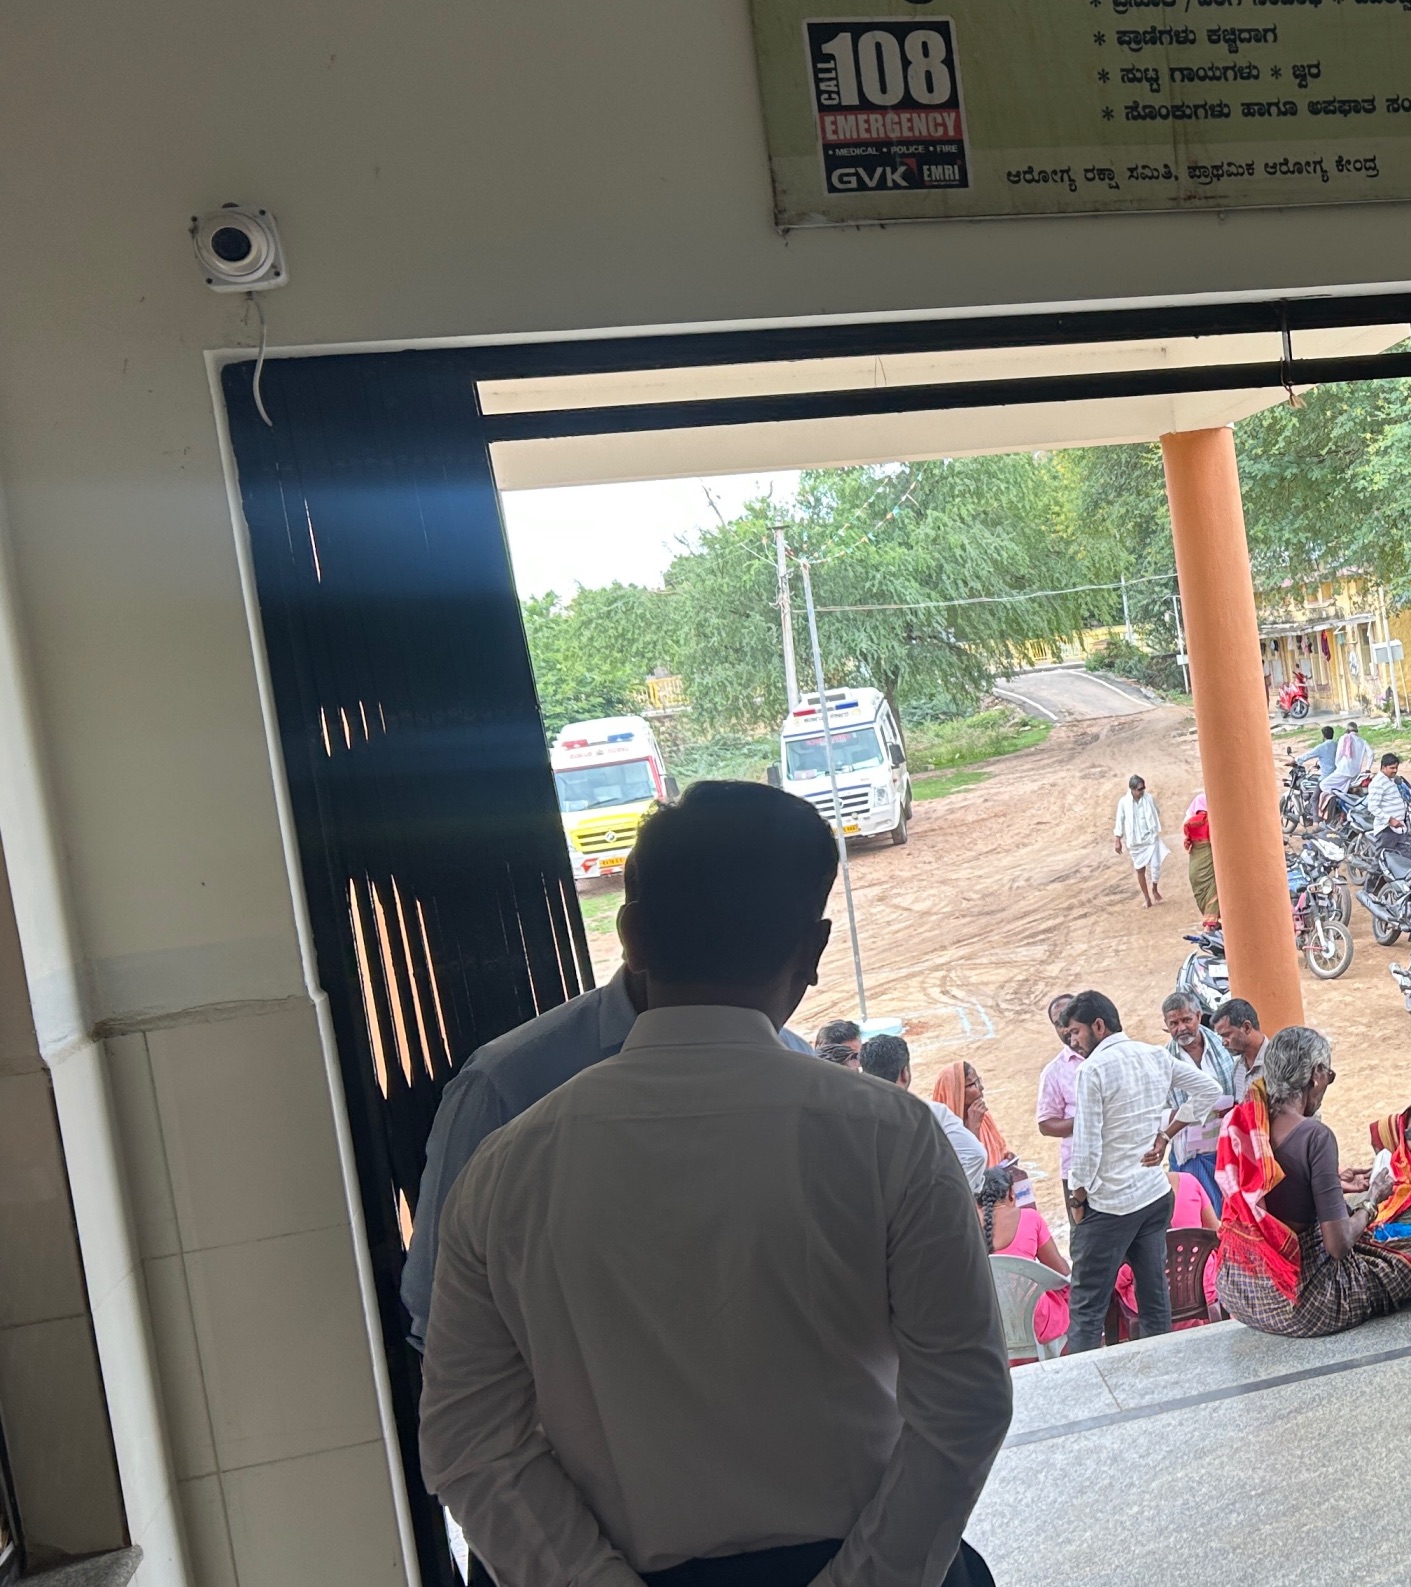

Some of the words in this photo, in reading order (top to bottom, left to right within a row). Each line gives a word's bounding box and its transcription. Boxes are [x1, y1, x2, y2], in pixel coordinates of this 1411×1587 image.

[1116, 25, 1197, 52] ಪ್ರಾಣಿಗಳು
[1207, 24, 1279, 54] ಕಚ್ಚಿದಾಗ
[817, 60, 840, 105] CALL
[821, 29, 951, 106] 108
[1120, 63, 1160, 93] ಸುಟ್ಟ
[1170, 61, 1260, 82] ಗಾಯಗಳು
[1292, 60, 1321, 88] ಜ್ವರ
[1241, 97, 1298, 117] ಹಾಗೂ
[1307, 95, 1376, 117] ಅಪಘಾತ
[824, 113, 957, 141] EMERGENCY
[835, 147, 880, 157] MEDICAL
[891, 145, 925, 155] POLICE
[937, 144, 958, 154] FIRE
[831, 165, 910, 189] GVK
[923, 164, 960, 181] EMRI
[1006, 165, 1077, 192] ಆರೋಗ್ಯ
[1126, 163, 1178, 182] ಸಮಿತಿ,
[1187, 160, 1255, 185] ಪ್ರಾಥಮಿಕ
[1263, 158, 1329, 183] ಆರೋಗ್ಯ
[1335, 155, 1380, 178] ಕೇಂದ್ರ
